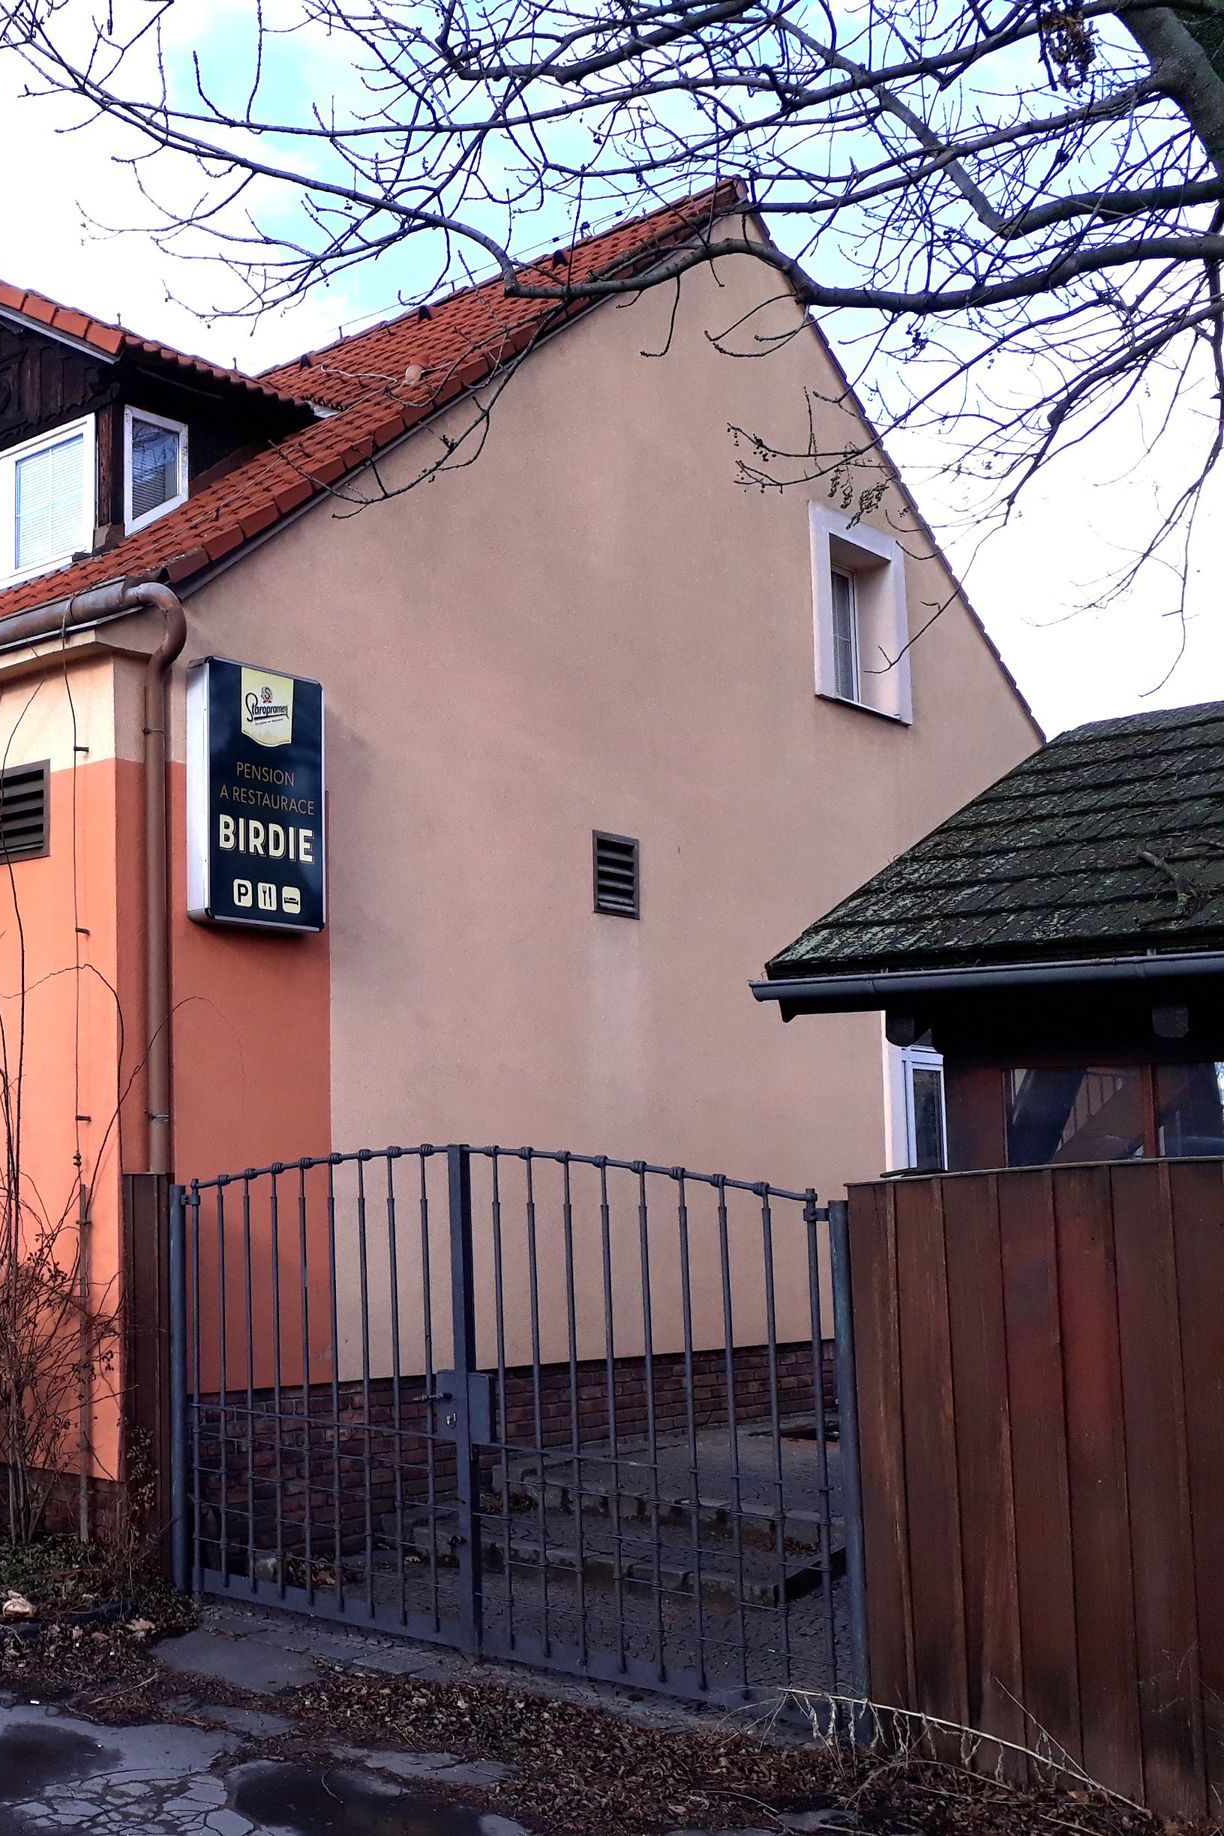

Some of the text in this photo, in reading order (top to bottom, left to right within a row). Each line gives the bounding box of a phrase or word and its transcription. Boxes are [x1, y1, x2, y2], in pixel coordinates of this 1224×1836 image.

[245, 692, 289, 722] Staropramen
[236, 761, 295, 788] PENSION
[219, 784, 316, 816] A RESTAURACE
[219, 813, 315, 865] BIRDIE
[237, 883, 249, 903] P
